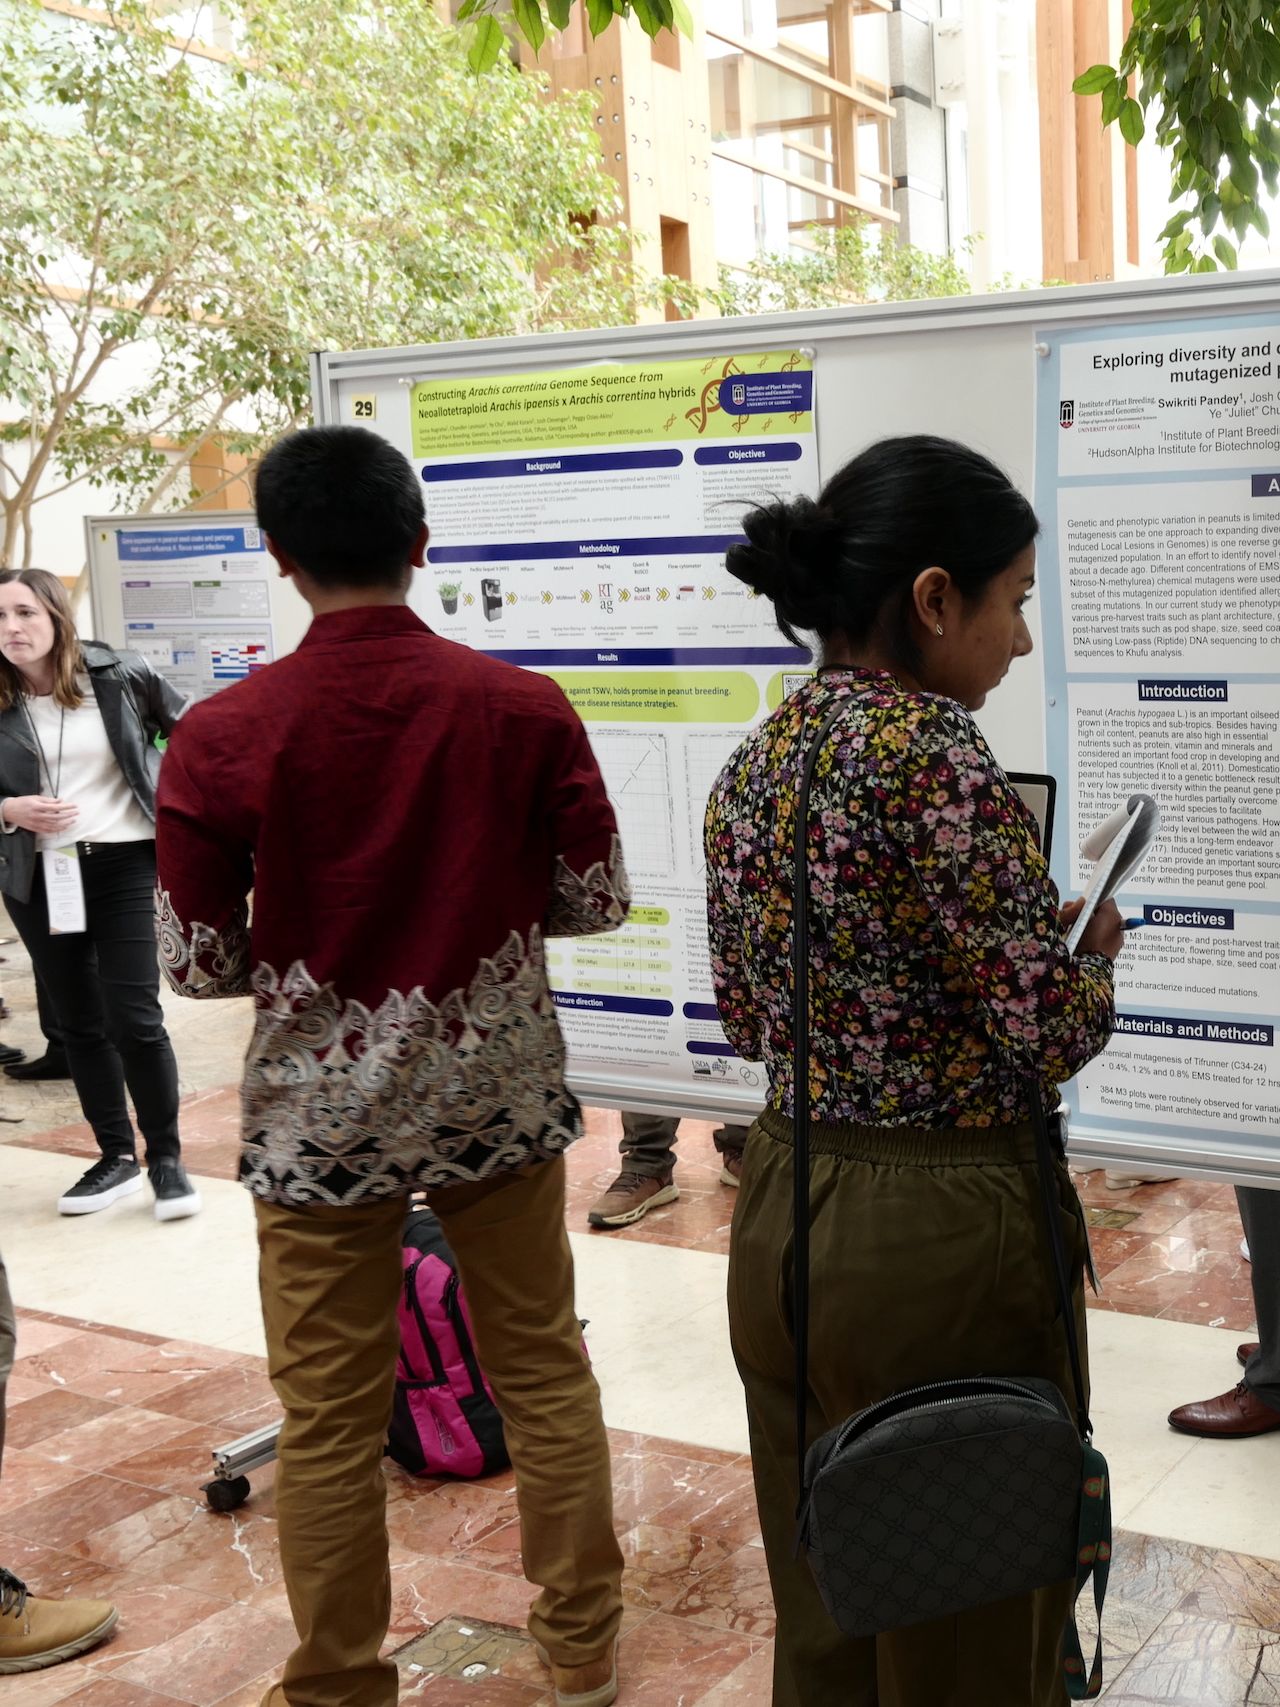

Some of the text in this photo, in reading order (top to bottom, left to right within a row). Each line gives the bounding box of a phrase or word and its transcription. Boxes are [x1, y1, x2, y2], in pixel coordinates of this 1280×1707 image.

[1093, 351, 1164, 372] Exploring
[1169, 345, 1236, 363] diversity
[1241, 341, 1271, 358] and
[1170, 361, 1271, 384] mutagenized
[418, 372, 663, 403] Constructing Arachis correntina Genome Sequence from
[418, 386, 696, 419] Neoallotetraploid Arachis ipaensis x Arachis correntina hybrids
[1158, 396, 1197, 409] Swikriti
[1250, 392, 1274, 403] Josh
[355, 401, 373, 417] 29
[1078, 406, 1145, 418] Genetics and Genomics
[1209, 408, 1222, 419] Ye
[1078, 425, 1108, 434] UNIVERSITY
[1205, 428, 1215, 439] of
[1217, 427, 1243, 439] Plant
[728, 449, 766, 461] Objectives
[1158, 444, 1196, 455] Institute
[1199, 442, 1213, 453] for
[526, 460, 561, 472] Background
[1067, 519, 1098, 528] Genetic
[1099, 518, 1115, 527] and
[1116, 517, 1160, 528] phenotypic
[1161, 516, 1196, 525] variation
[1198, 514, 1206, 524] in
[1208, 514, 1241, 525] peanuts
[1243, 514, 1251, 522] is
[1252, 512, 1280, 521] limited
[579, 544, 620, 554] Methodology
[597, 653, 619, 662] Results
[1074, 648, 1185, 659] sequences to Khufu analysis.
[569, 686, 731, 697] against TSWV, holds promise in peanut breeding.
[1141, 684, 1225, 698] Introduction
[587, 699, 678, 709] disease resistance strategies.
[1076, 707, 1103, 717] Peanut
[1105, 708, 1136, 718] (Arachis
[1137, 709, 1175, 721] hypogaea
[1177, 709, 1188, 721] L.)
[1189, 709, 1197, 718] is
[1198, 711, 1209, 719] an
[1210, 710, 1249, 722] important
[1250, 710, 1280, 720] oilseed
[1152, 909, 1226, 926] Objectives
[556, 995, 603, 1007] future direction
[1114, 1017, 1268, 1042] Materials and Methods
[1108, 1062, 1280, 1088] 0.4%, 1.2% and 0.8% EMS treated for 12 hrs
